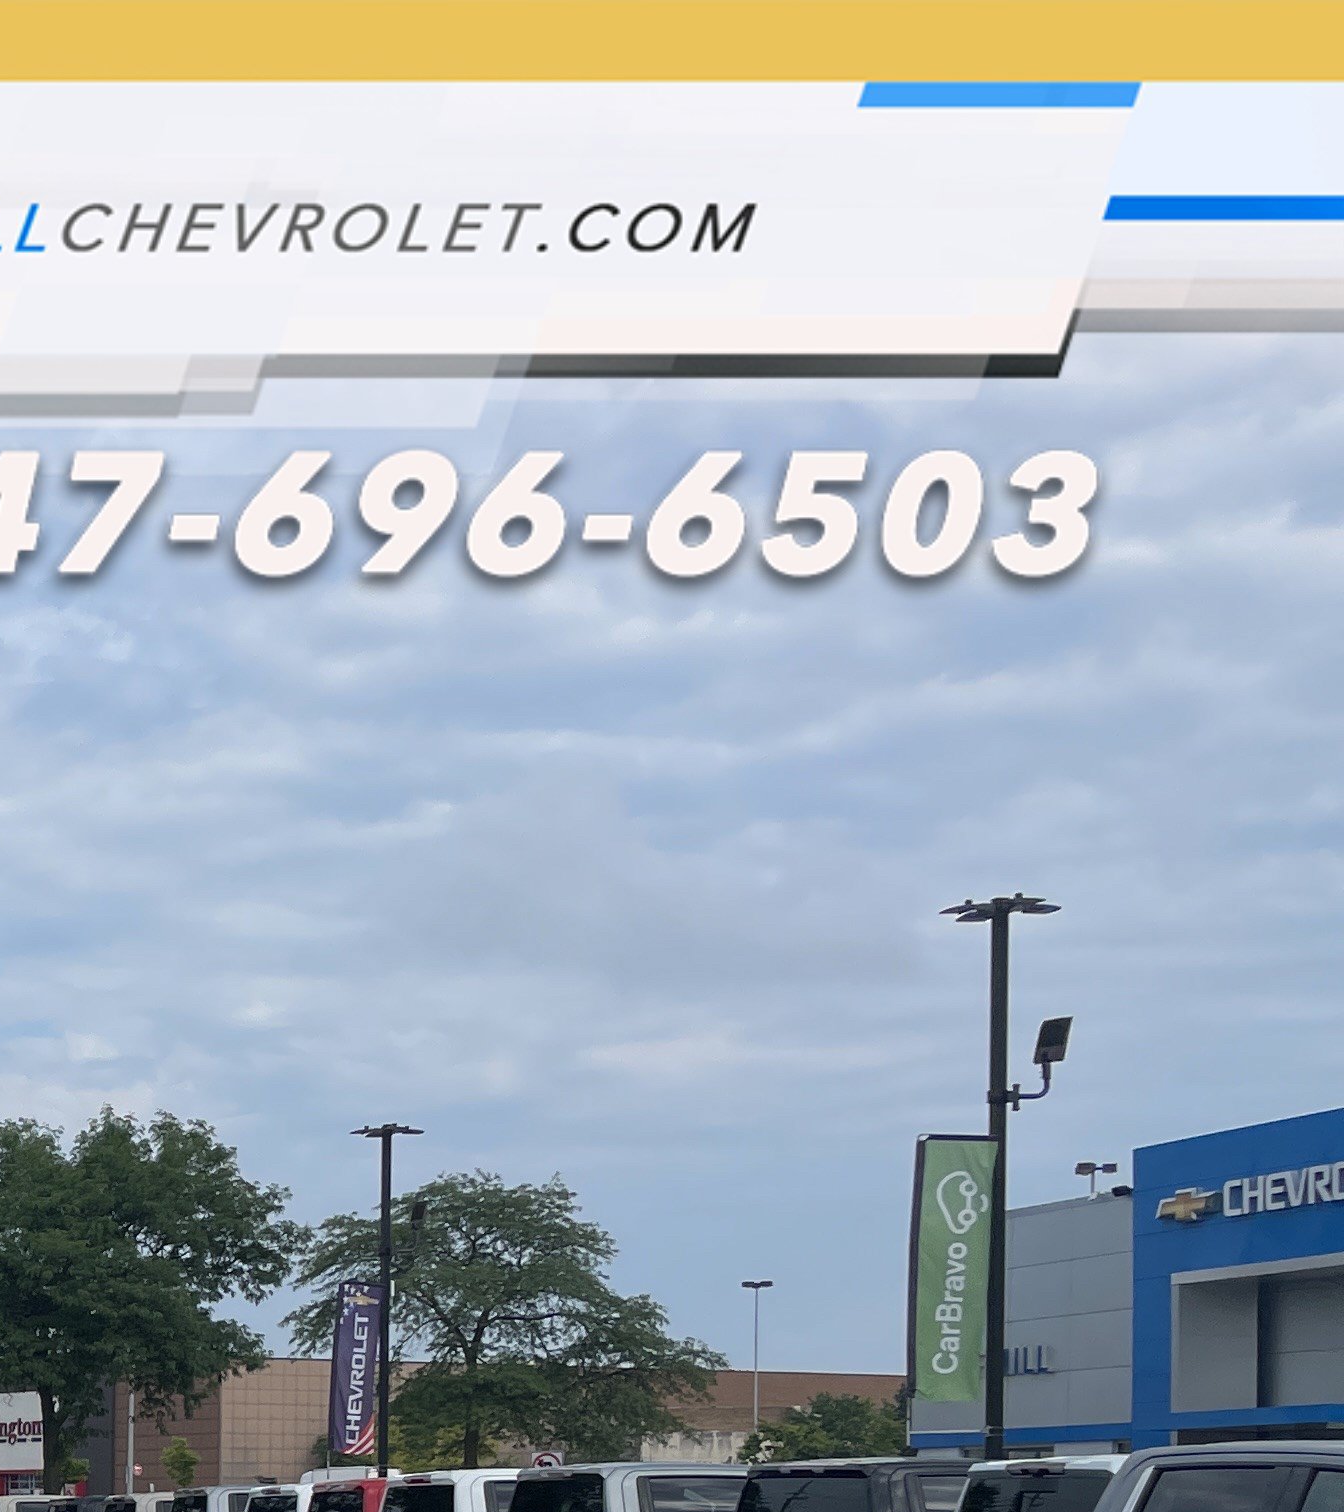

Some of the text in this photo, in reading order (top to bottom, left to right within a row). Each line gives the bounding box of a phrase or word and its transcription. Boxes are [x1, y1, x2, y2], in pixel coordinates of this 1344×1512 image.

[932, 1242, 967, 1374] CarBravo
[1003, 1345, 1048, 1376] ILL
[346, 1312, 369, 1445] CHEVROLET
